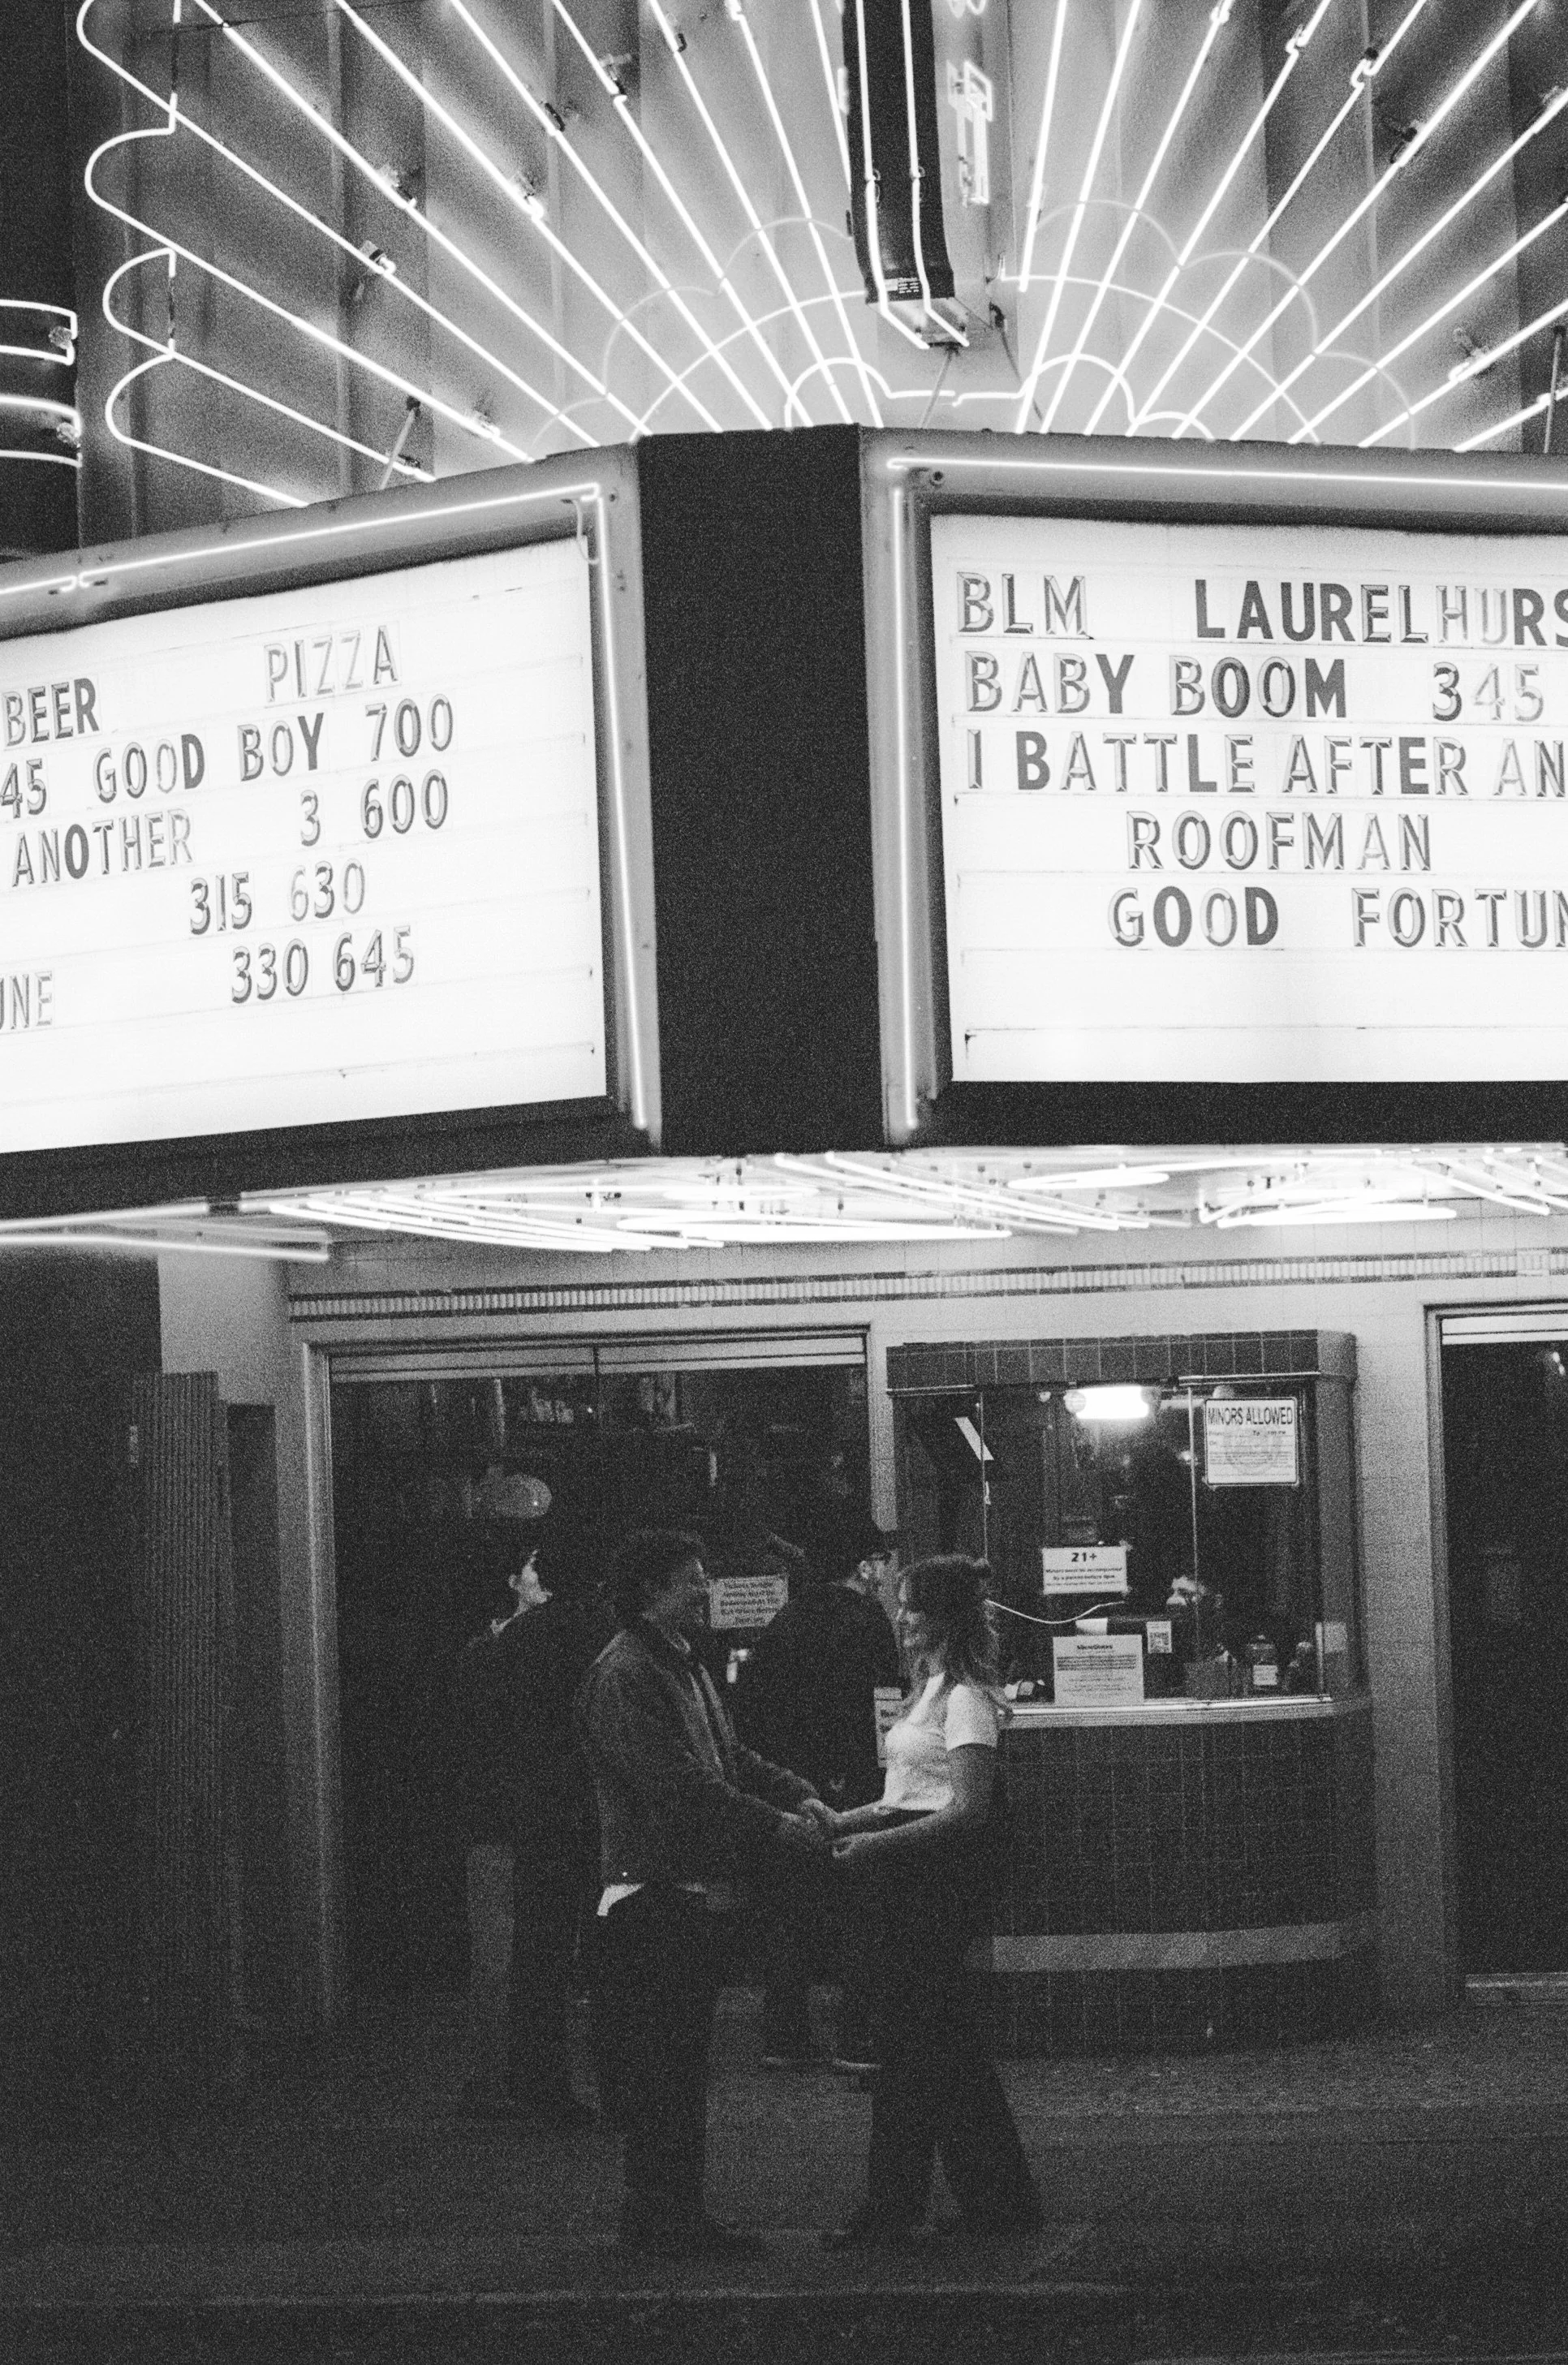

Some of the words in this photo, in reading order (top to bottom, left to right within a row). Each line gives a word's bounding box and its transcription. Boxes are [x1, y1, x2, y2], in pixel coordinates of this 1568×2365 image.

[954, 570, 1088, 636] BLM
[2, 675, 100, 747] BEER
[264, 625, 398, 703] PIZZA
[963, 650, 1135, 715] BABY
[1170, 653, 1347, 719] BOOM
[1432, 661, 1544, 722] 345
[0, 757, 47, 820] 45
[93, 733, 205, 805] GOOD
[236, 711, 325, 782] BOY
[364, 694, 454, 763] 700
[1015, 730, 1256, 794] BATTLE
[1280, 734, 1470, 796] AFTER
[1493, 739, 1566, 798] AN
[11, 807, 195, 888] ANOTHER
[300, 790, 321, 848] 3
[360, 769, 449, 840] 600
[1126, 809, 1432, 871] ROOFMAN
[190, 871, 253, 937] 315
[291, 860, 365, 923] 630
[1108, 885, 1282, 949] GOOD
[0, 971, 53, 1031] NE
[231, 937, 309, 1006] 330
[333, 925, 415, 993] 645
[1208, 1407, 1243, 1425] MINORS
[1247, 1407, 1293, 1425] ALLOWED
[1071, 1552, 1097, 1562] 21+
